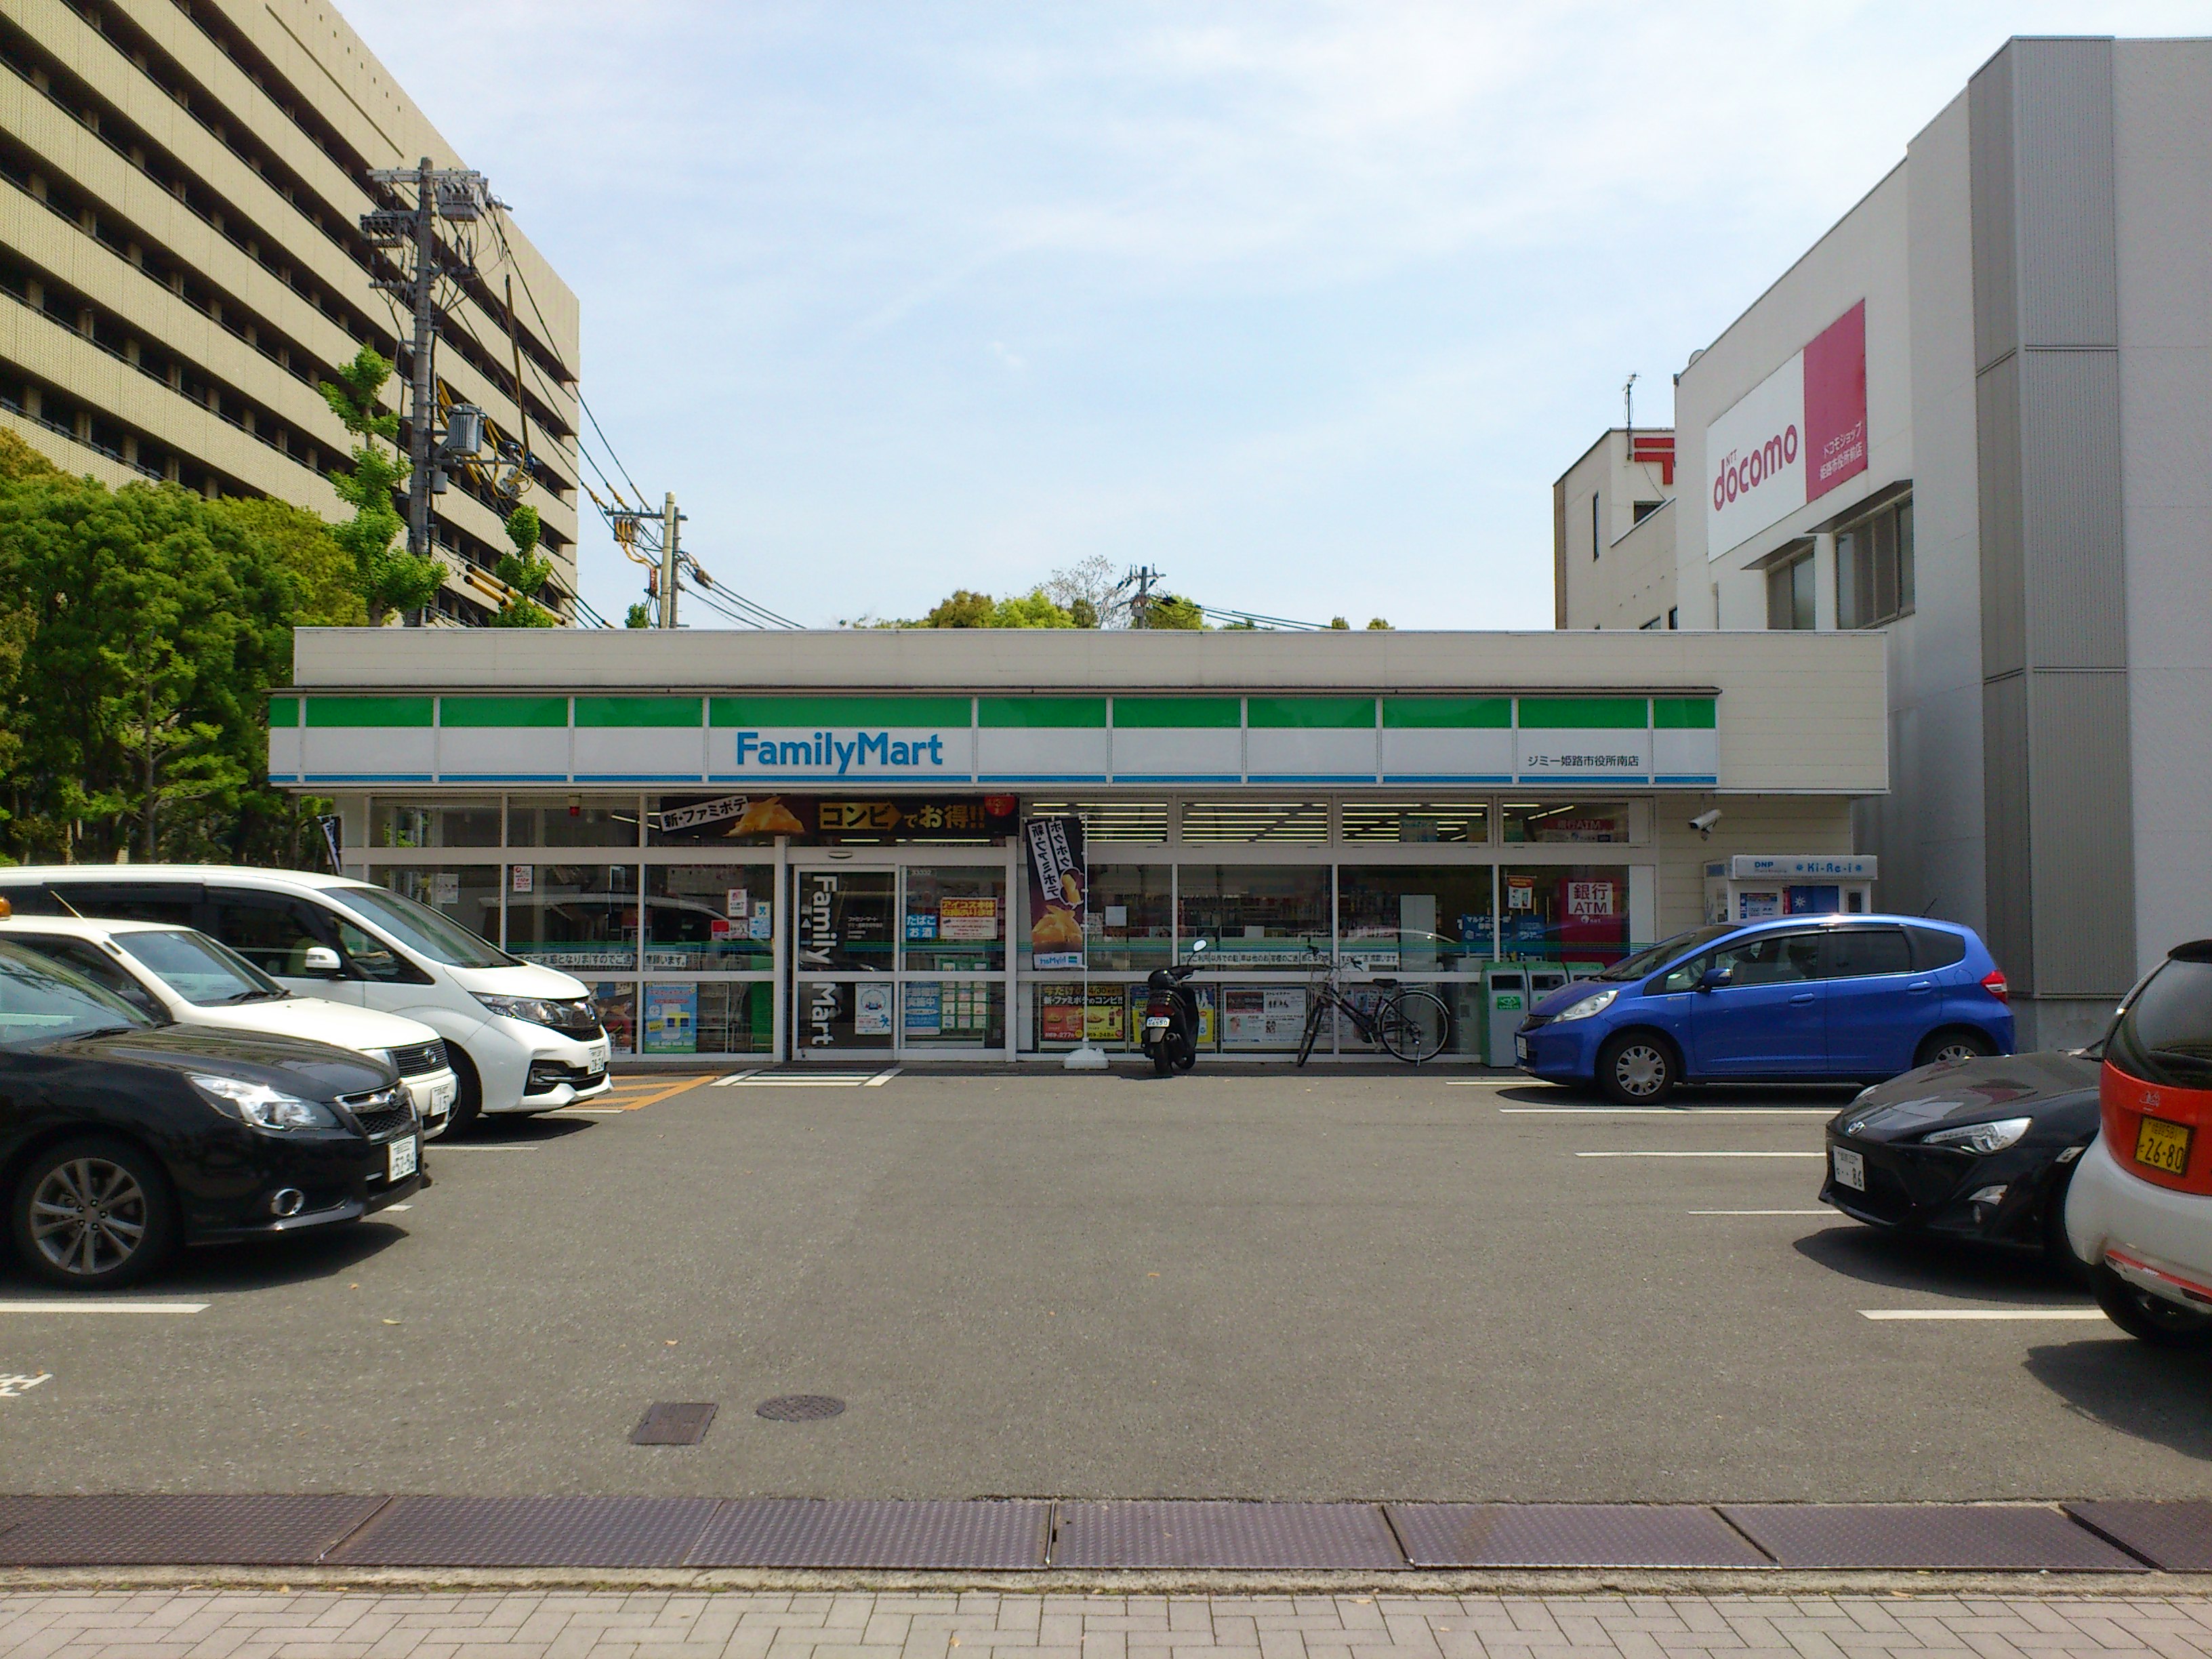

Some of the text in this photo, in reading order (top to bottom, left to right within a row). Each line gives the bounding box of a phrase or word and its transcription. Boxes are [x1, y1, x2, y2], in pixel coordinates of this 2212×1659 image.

[1823, 421, 1862, 458] ドコモショップ
[1714, 424, 1797, 511] docomo
[1726, 449, 1737, 466] NTT
[737, 732, 943, 774] FamilyMart
[1528, 756, 1639, 766] ジミー姫路市役所南店
[663, 798, 746, 827] 新・ファミポテ
[1574, 884, 1607, 900] 銀行
[1574, 902, 1607, 913] ATM
[907, 915, 936, 926] たばこ
[909, 927, 933, 937] お酒
[812, 876, 837, 1045] Family Mart
[2145, 1138, 2184, 1170] 26-80
